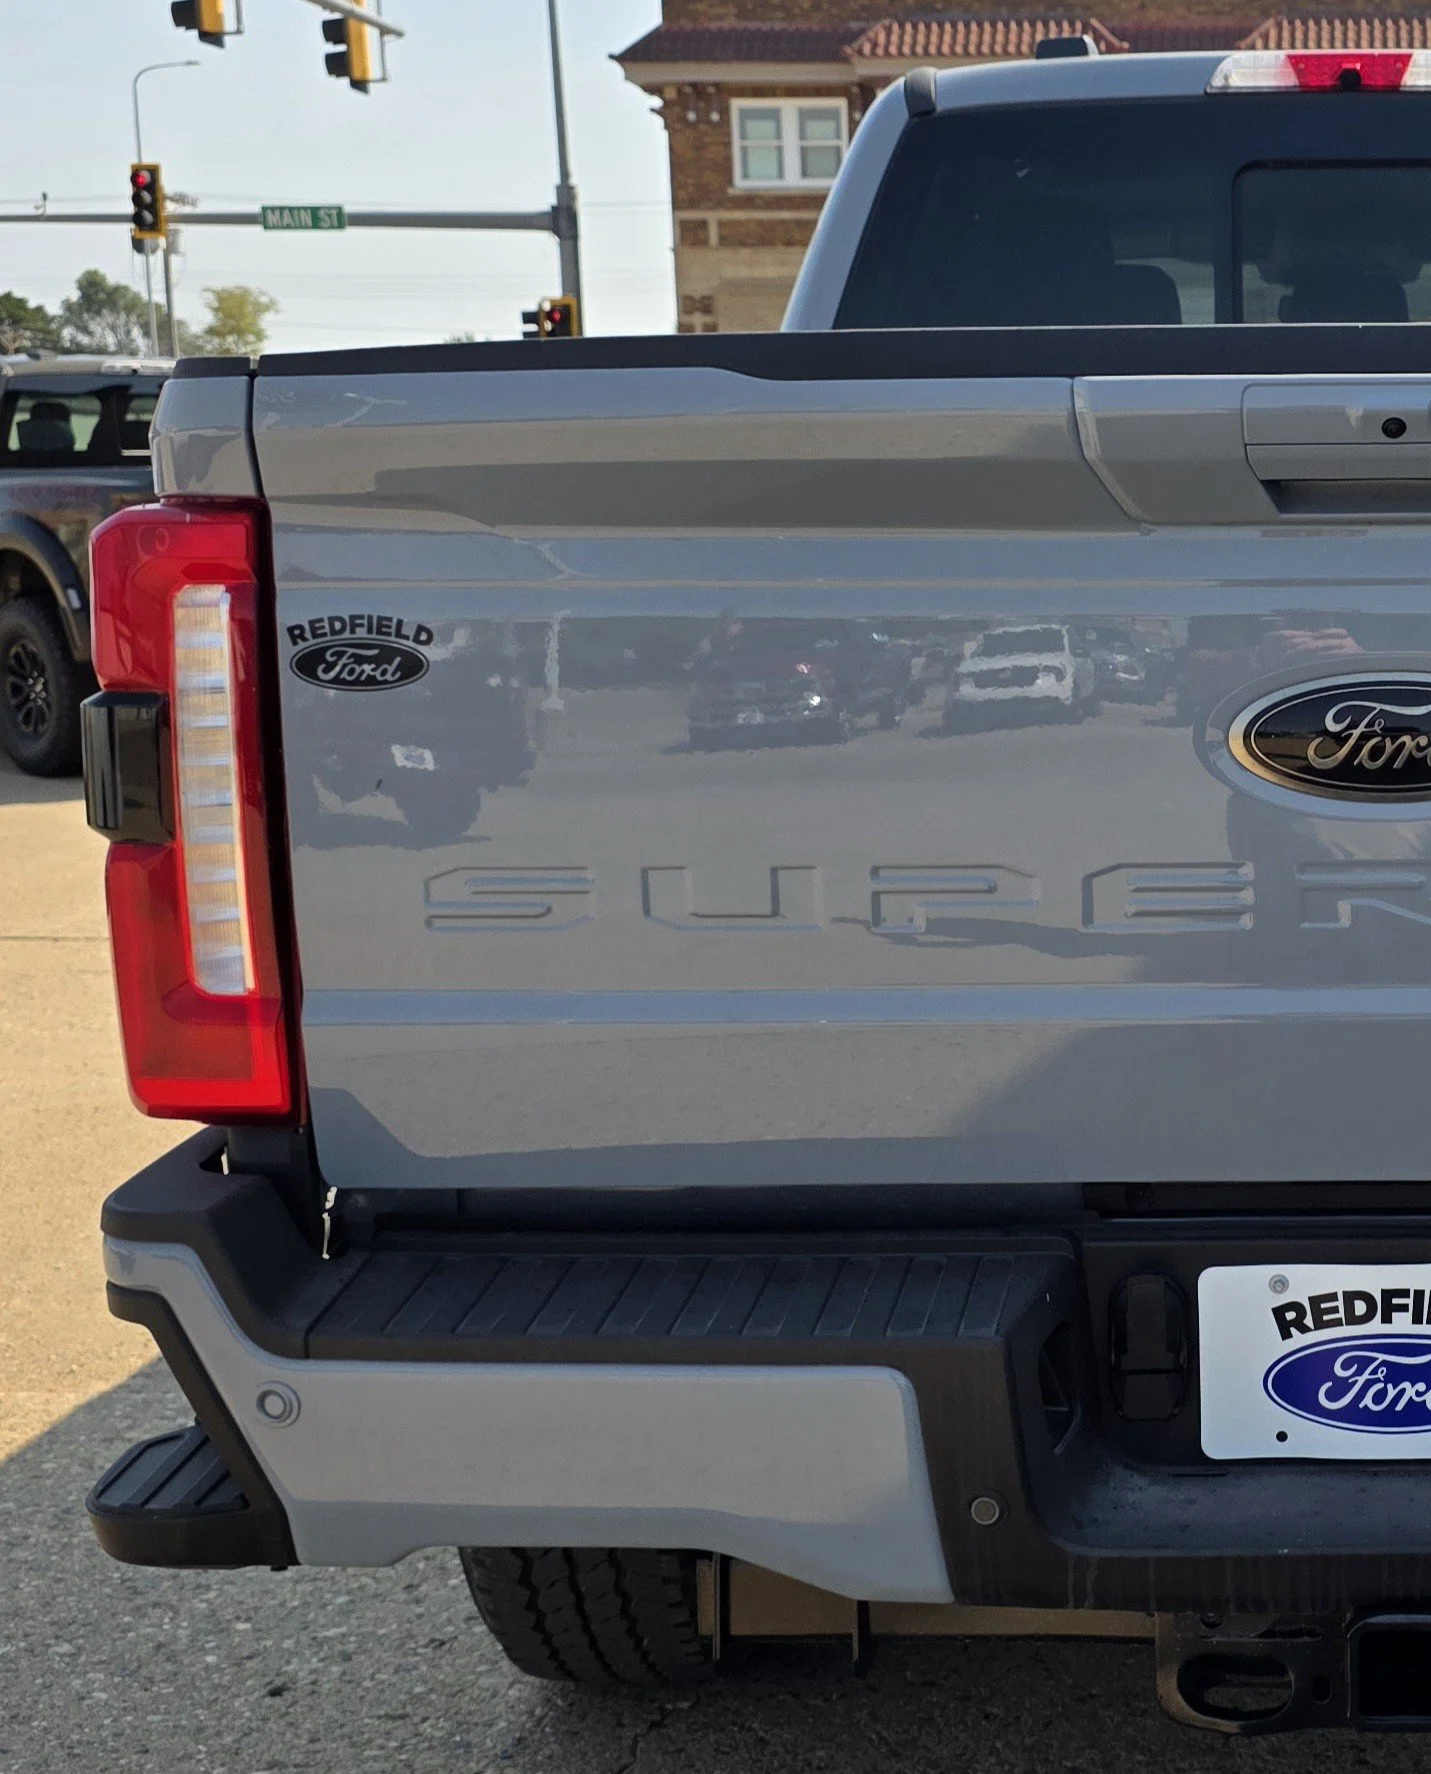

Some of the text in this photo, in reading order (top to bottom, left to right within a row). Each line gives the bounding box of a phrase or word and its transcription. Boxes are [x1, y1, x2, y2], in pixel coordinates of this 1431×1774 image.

[266, 208, 340, 227] MAIN ST
[286, 614, 434, 646] REDFIELD
[317, 647, 402, 681] Ford
